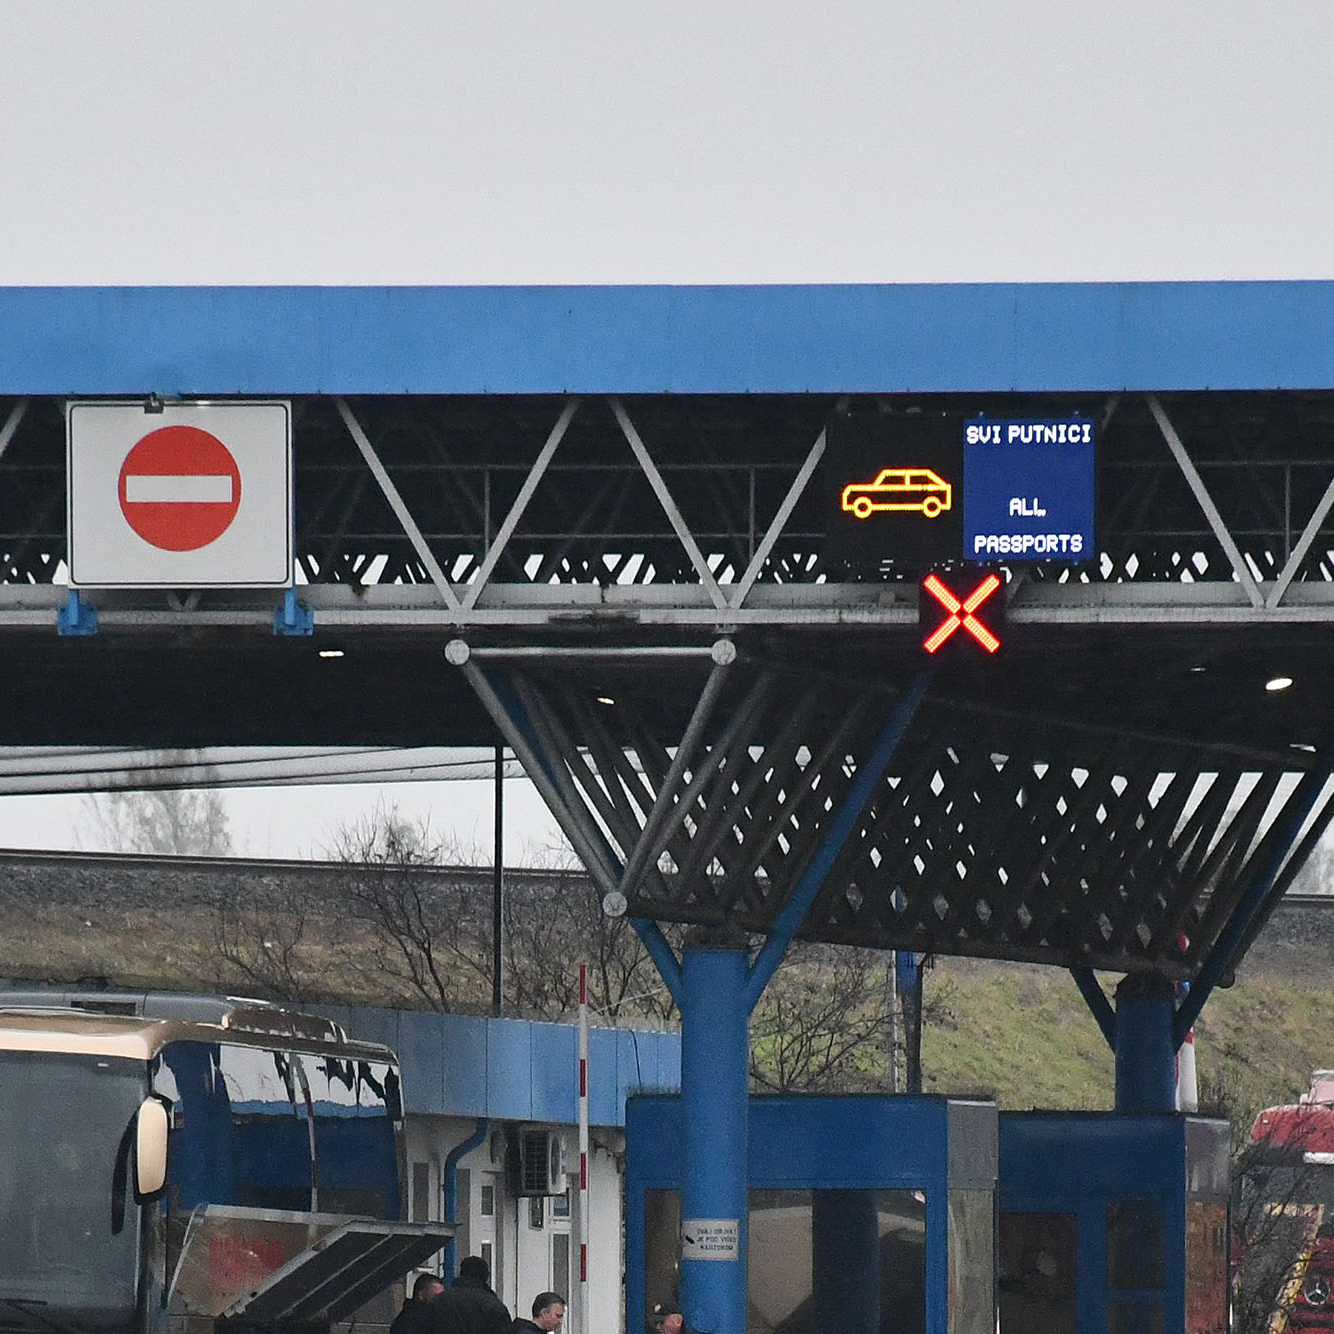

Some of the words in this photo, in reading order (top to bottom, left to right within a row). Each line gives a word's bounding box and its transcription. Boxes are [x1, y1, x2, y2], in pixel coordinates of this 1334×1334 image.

[966, 425, 1001, 444] SVI
[1008, 424, 1091, 444] PUTNICI
[1009, 497, 1046, 517] ALL
[974, 534, 1083, 553] PASSPORTS
